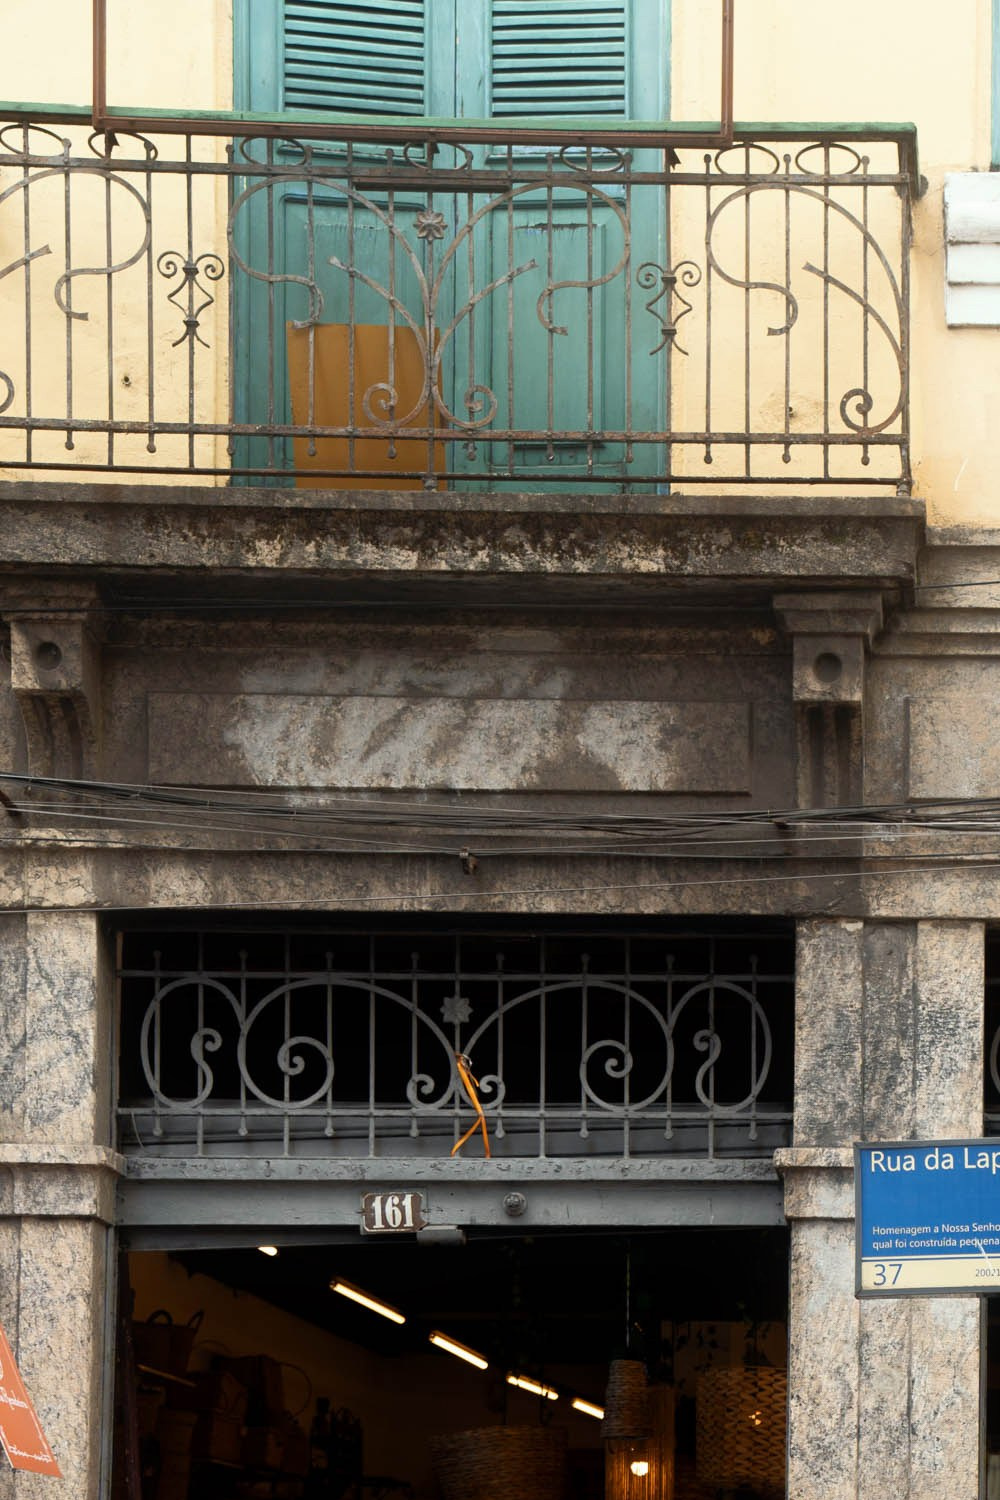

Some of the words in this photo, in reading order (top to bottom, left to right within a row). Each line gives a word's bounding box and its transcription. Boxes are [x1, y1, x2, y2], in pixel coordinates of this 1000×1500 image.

[870, 1151, 916, 1173] Rua
[924, 1147, 954, 1170] da
[371, 1194, 415, 1229] 161
[872, 1225, 931, 1237] Homenagem
[941, 1223, 970, 1233] Nossa
[872, 1239, 893, 1250] qual
[895, 1238, 907, 1248] foi
[909, 1237, 957, 1248] construída
[959, 1237, 1000, 1249] pequena
[873, 1263, 903, 1286] 37
